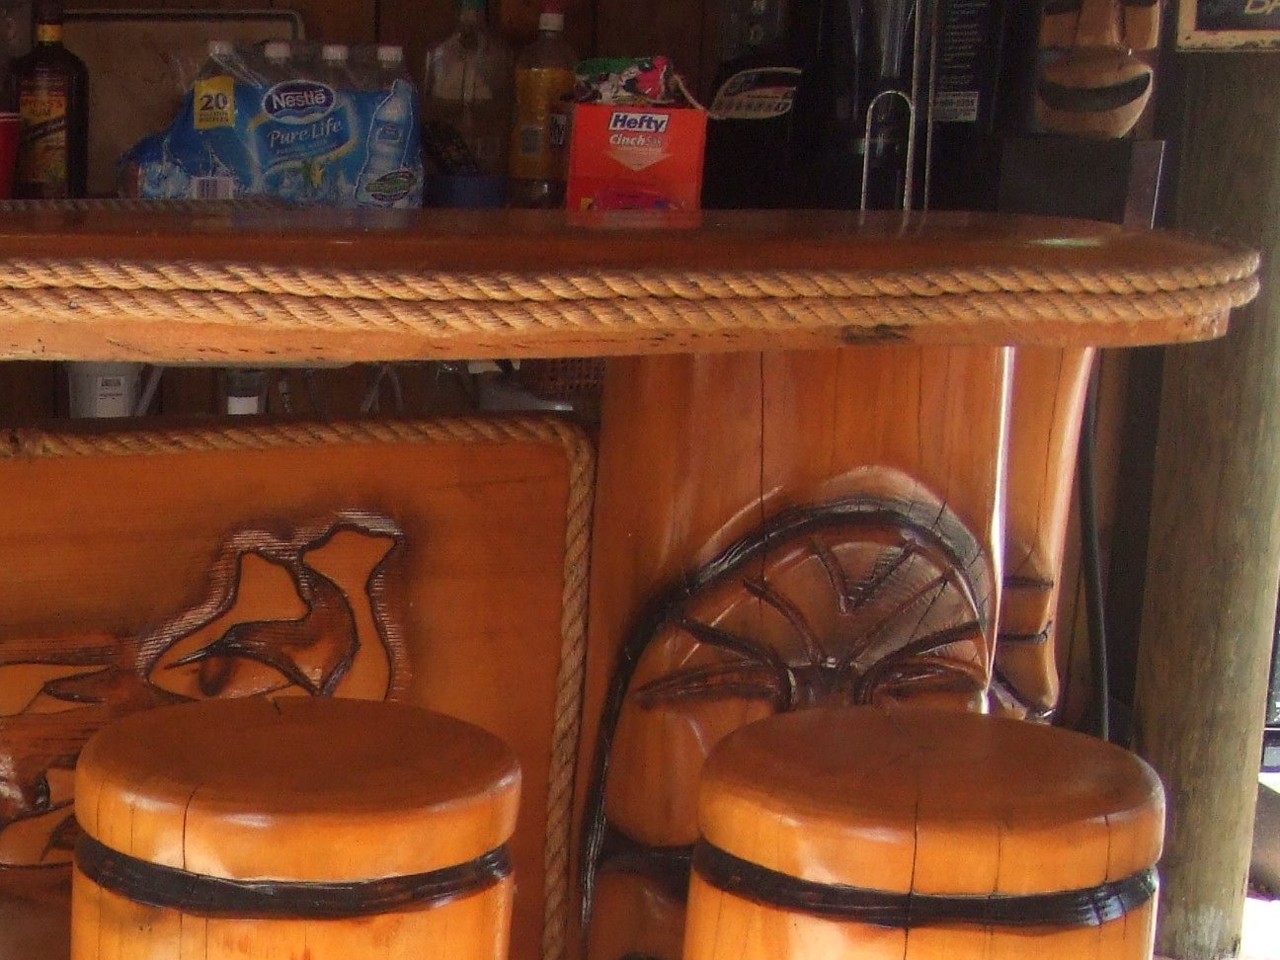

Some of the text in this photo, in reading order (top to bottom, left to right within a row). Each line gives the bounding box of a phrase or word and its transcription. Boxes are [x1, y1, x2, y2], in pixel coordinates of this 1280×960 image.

[200, 92, 228, 111] 20
[272, 88, 326, 109] Nestlé
[268, 117, 342, 148] Pure Life
[612, 114, 666, 132] Hefty
